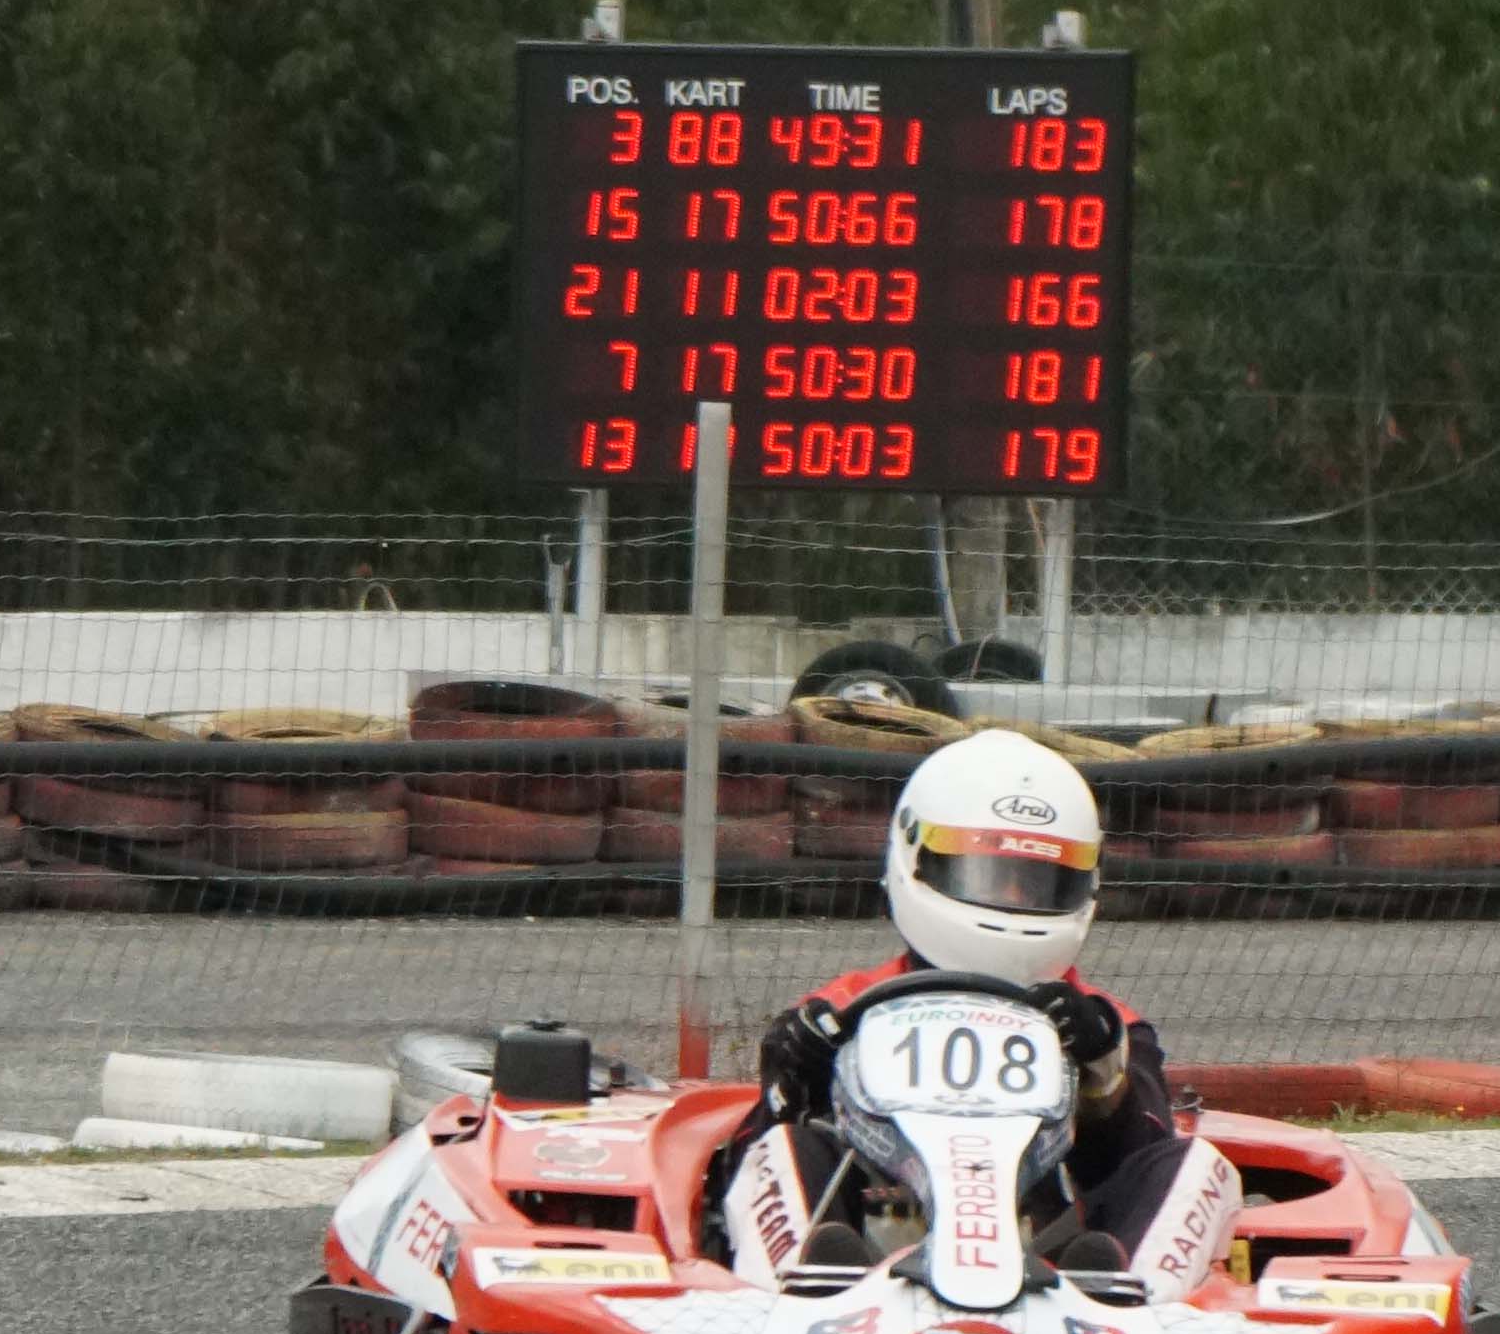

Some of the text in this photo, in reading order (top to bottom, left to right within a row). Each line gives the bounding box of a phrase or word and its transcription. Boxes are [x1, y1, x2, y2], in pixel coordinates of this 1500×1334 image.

[568, 76, 1068, 116] POS. KART TIME LAPS
[610, 111, 642, 164] 3
[667, 112, 742, 166] 88
[1011, 117, 1106, 171] 183
[585, 188, 639, 241] 15
[686, 190, 741, 241] 17
[1008, 195, 1105, 249] 178
[564, 265, 639, 317] 21
[683, 269, 739, 317] 11
[1007, 273, 1101, 328] 166
[609, 341, 639, 393] 7
[682, 343, 738, 395] 17
[1006, 350, 1101, 404] 181
[581, 419, 637, 472] 13
[1003, 428, 1100, 483] 179
[999, 798, 1049, 819] Arai
[891, 1010, 1031, 1030] EUROINDY
[892, 1026, 1036, 1094] 108
[750, 1180, 799, 1268] TEAM
[949, 1134, 999, 1270] FERBERTO
[1158, 1157, 1230, 1281] RACING
